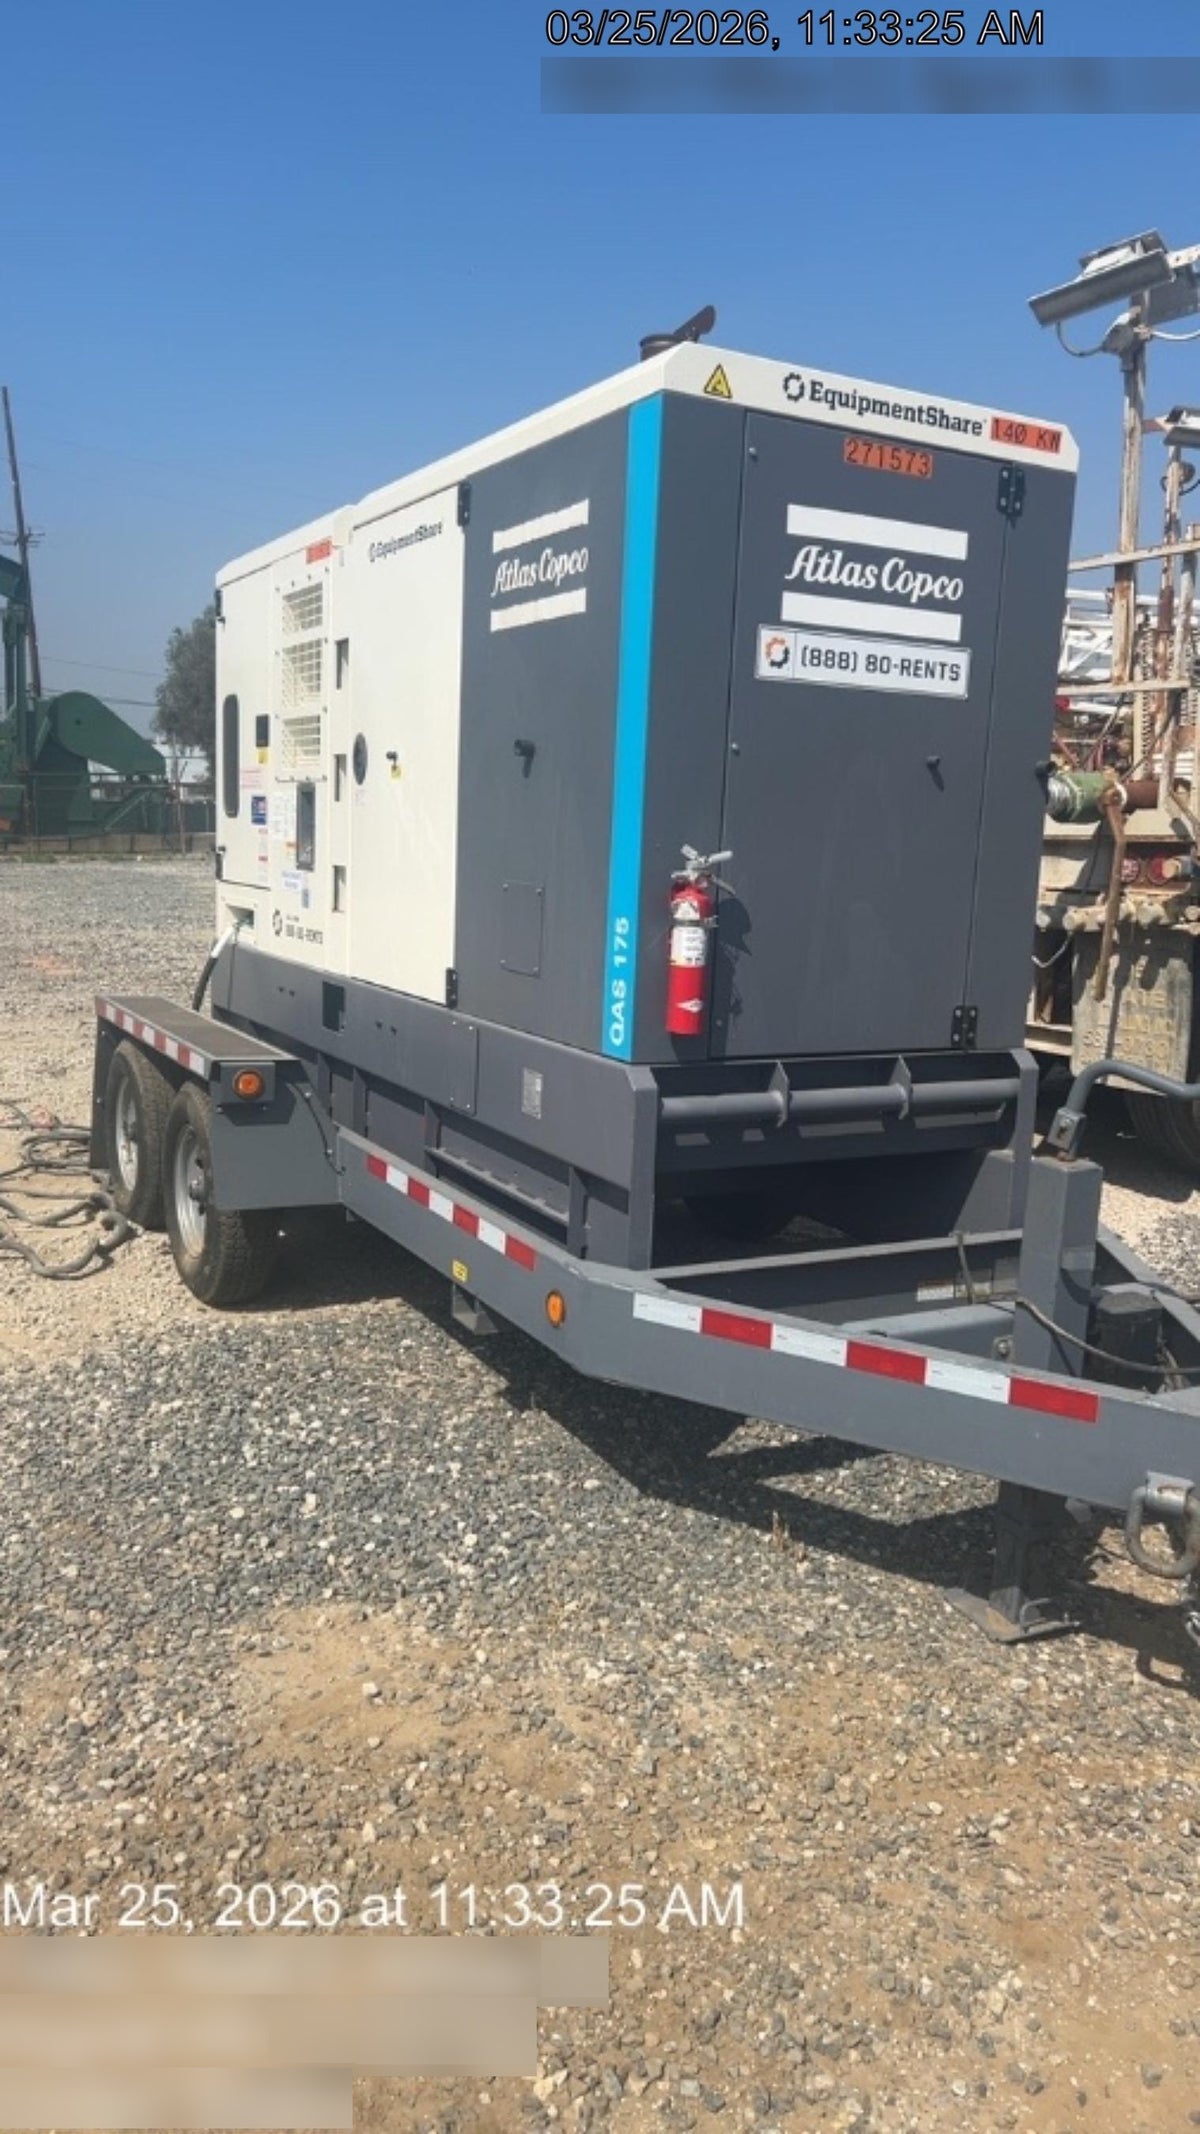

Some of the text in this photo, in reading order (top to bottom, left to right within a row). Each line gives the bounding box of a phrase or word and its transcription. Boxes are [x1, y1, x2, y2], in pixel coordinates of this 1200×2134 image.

[809, 378, 984, 437] EquipmentShare
[845, 437, 931, 476] 271573
[1036, 426, 1062, 454] KW
[490, 546, 589, 598] Atlas Copco
[784, 544, 964, 604] Atlas Copco
[800, 645, 961, 682] (888) 80-RENTS
[608, 916, 630, 1047] QAS 175
